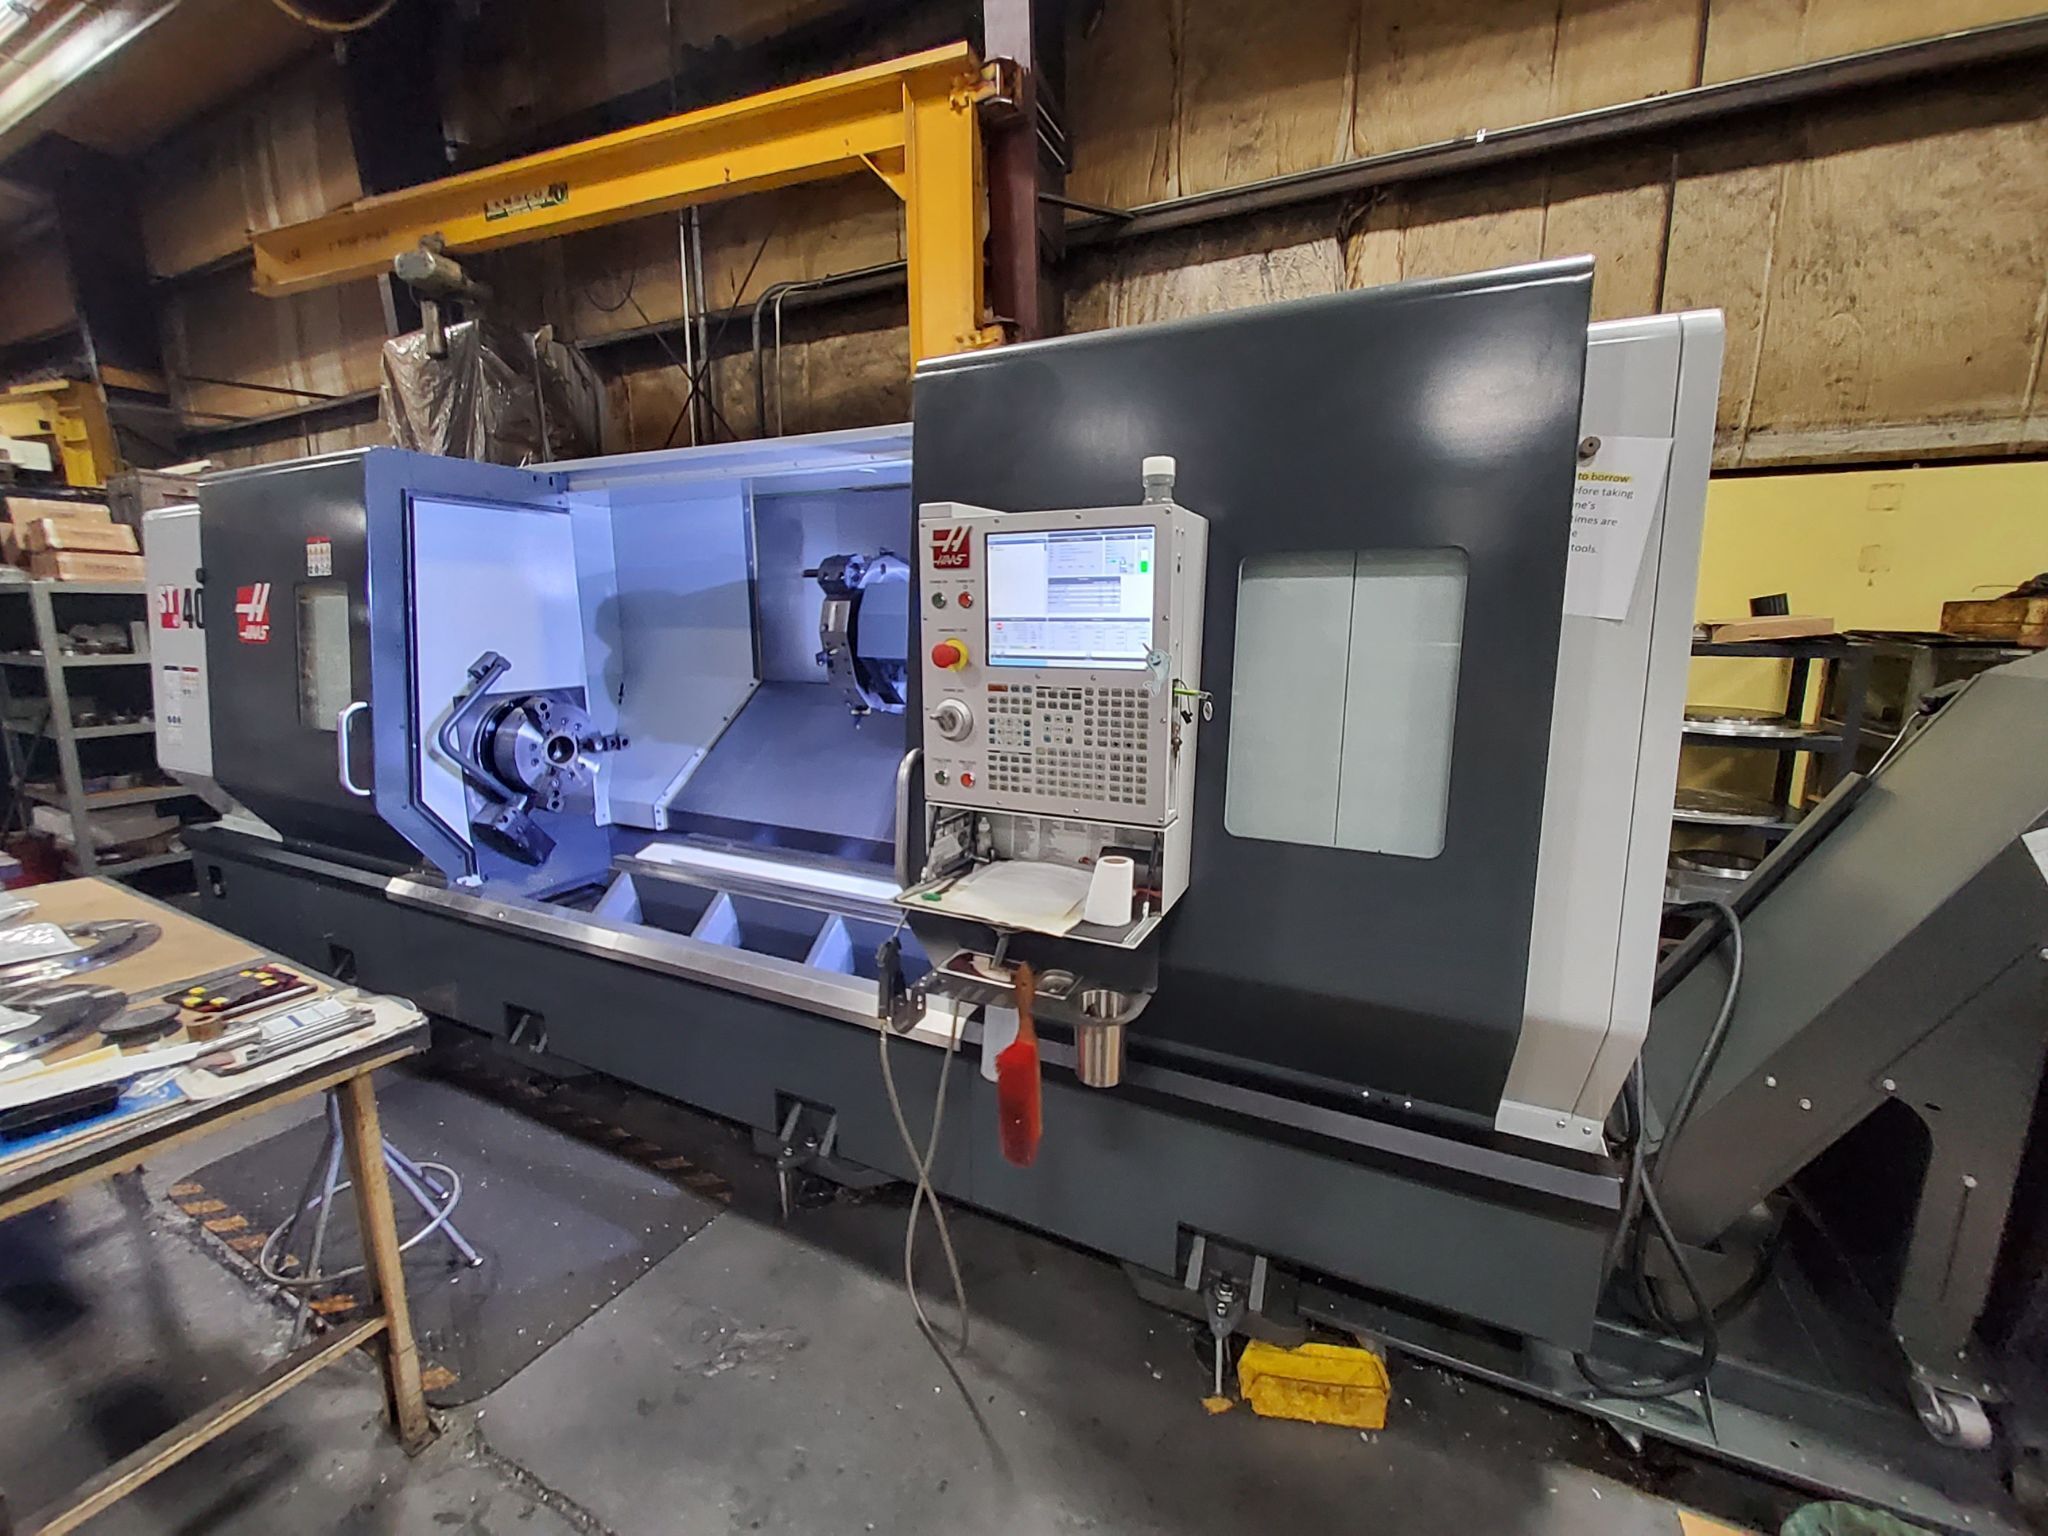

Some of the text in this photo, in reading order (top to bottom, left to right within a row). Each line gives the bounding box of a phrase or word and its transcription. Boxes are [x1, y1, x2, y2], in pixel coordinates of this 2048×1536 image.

[1578, 472, 1629, 482] to borrow
[1602, 488, 1634, 499] taking
[1600, 519, 1618, 527] are
